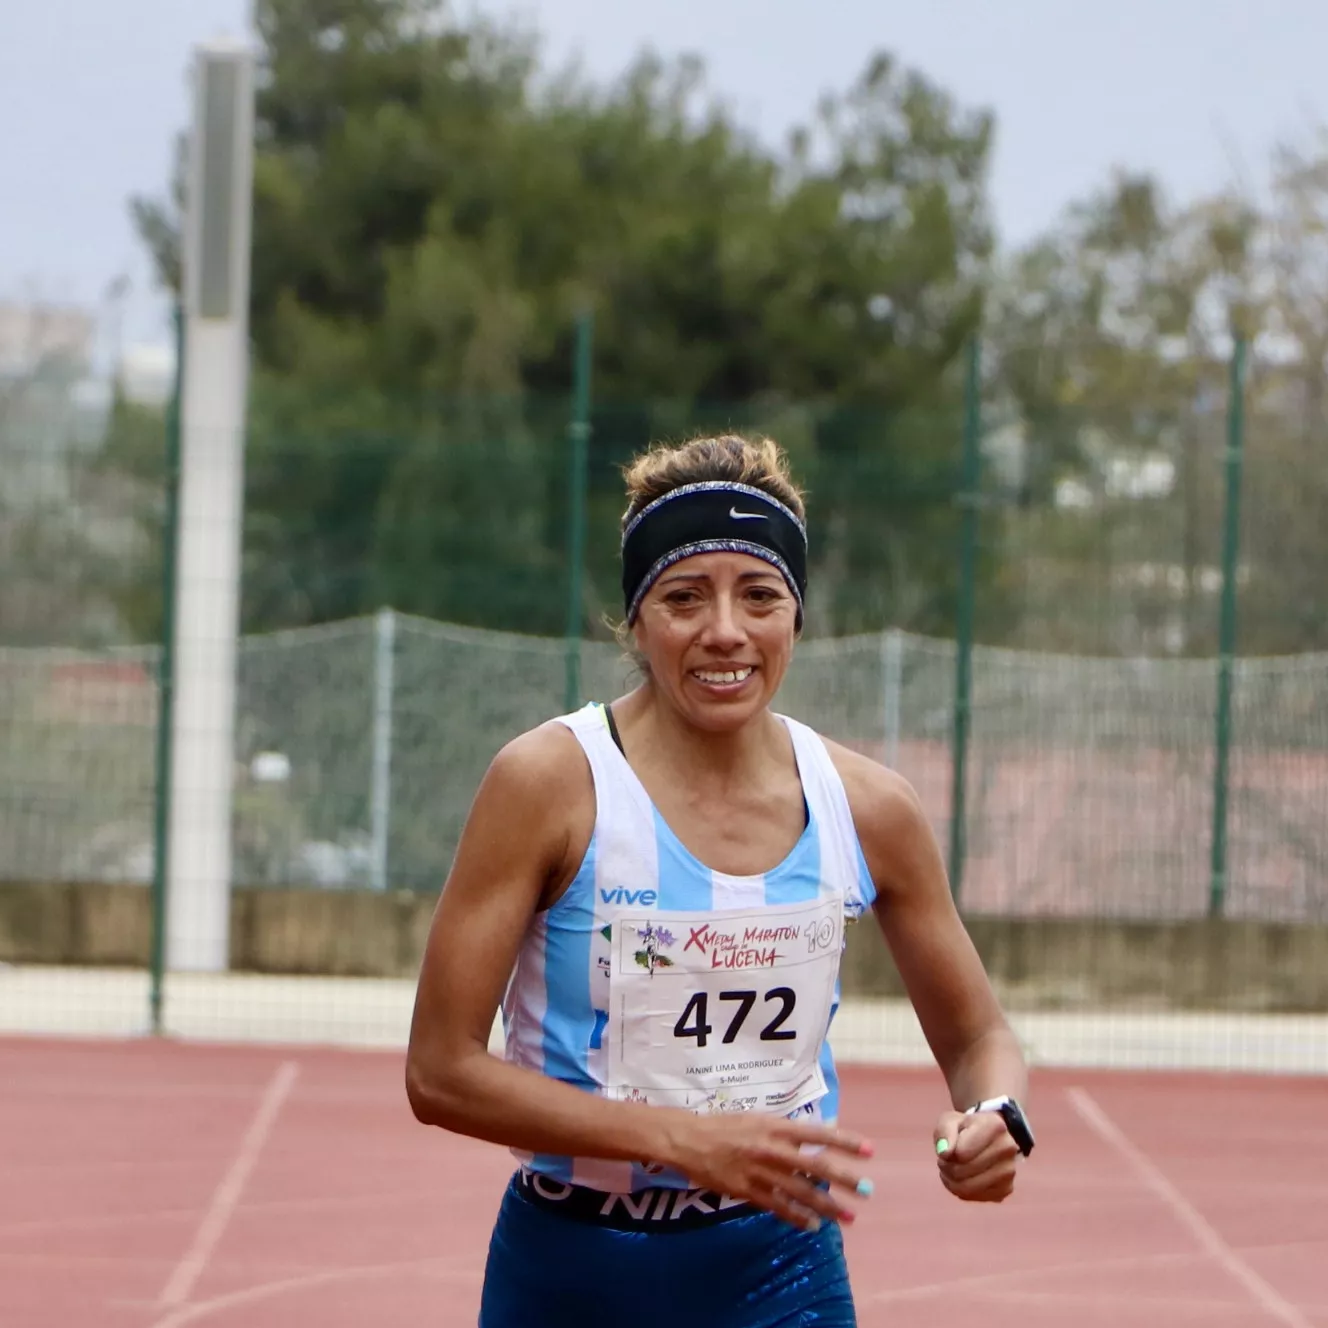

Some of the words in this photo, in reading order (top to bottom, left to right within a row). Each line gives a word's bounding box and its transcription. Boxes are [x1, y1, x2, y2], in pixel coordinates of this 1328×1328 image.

[600, 885, 657, 906] vive
[711, 947, 787, 969] LUCENA
[674, 986, 797, 1047] 472
[686, 1065, 713, 1075] JANINE
[715, 1063, 736, 1072] LIMA
[737, 1058, 784, 1070] RODRIGUEZ
[720, 1075, 750, 1085] S-Mujer
